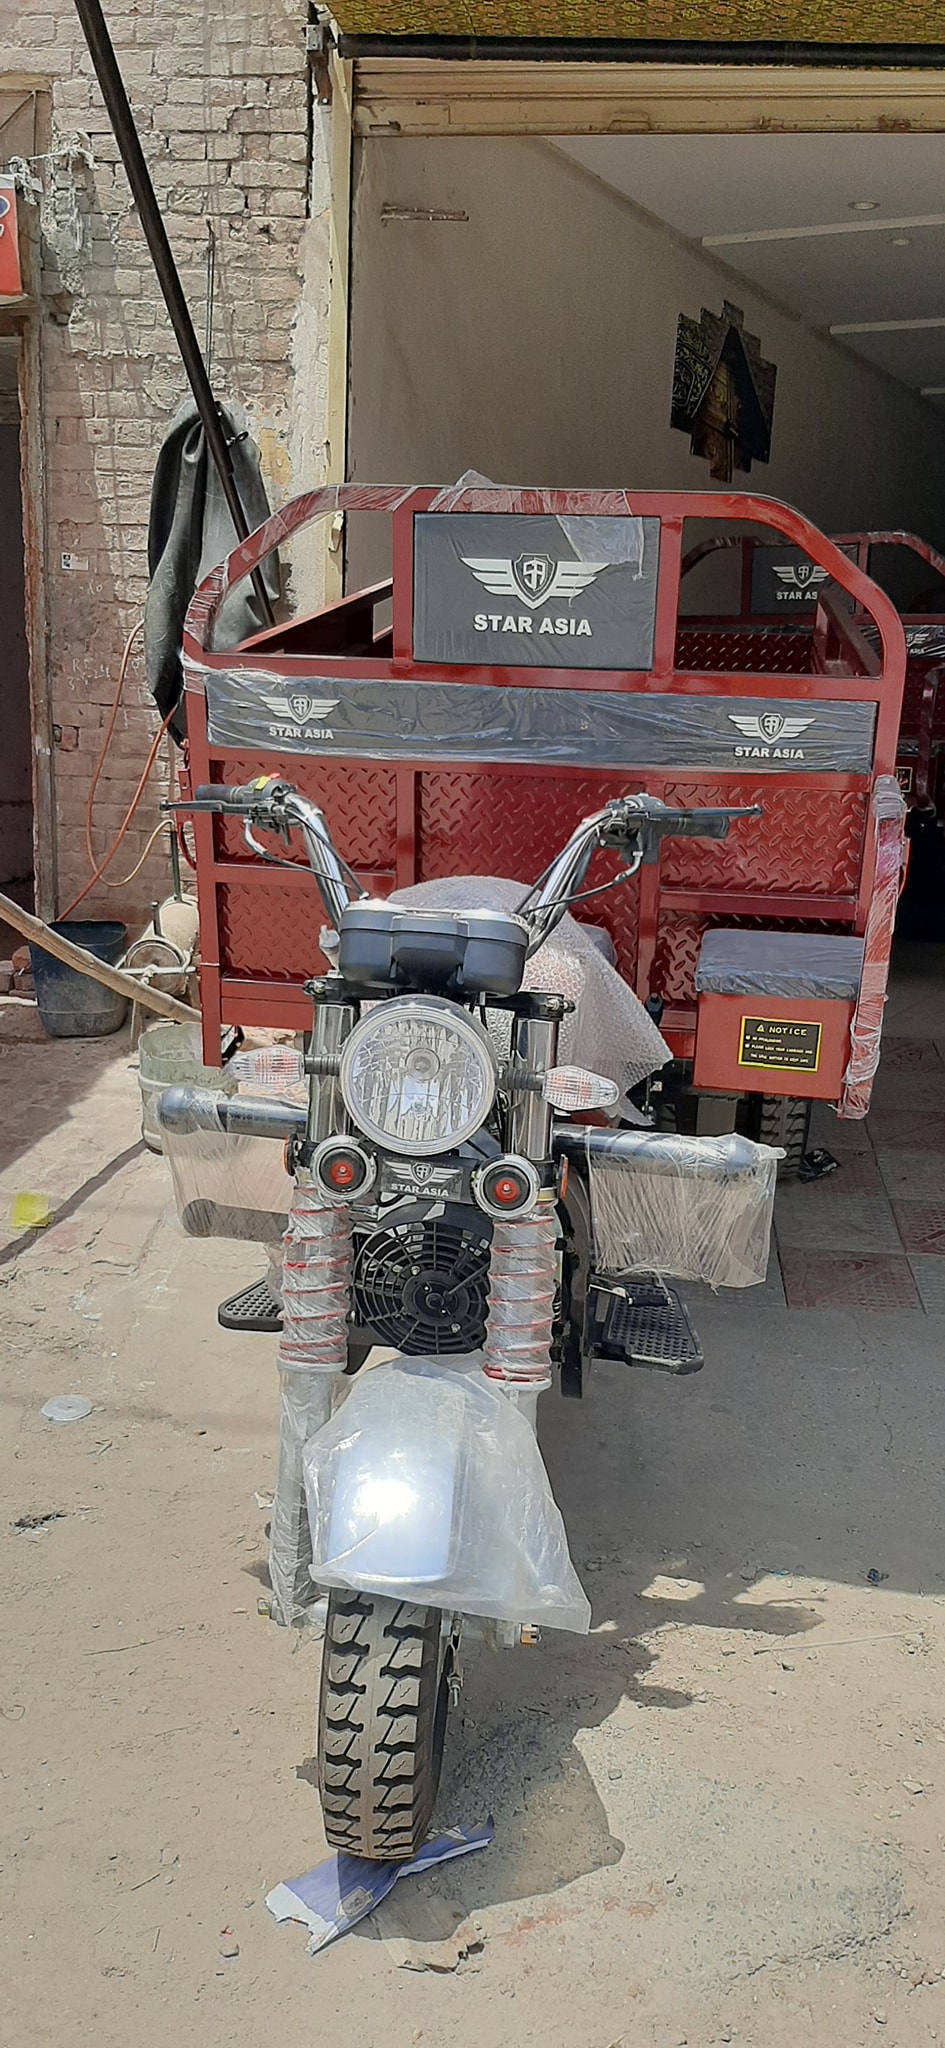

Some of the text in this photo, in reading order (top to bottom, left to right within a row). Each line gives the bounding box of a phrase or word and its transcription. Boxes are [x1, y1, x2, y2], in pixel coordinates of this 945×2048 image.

[776, 591, 818, 600] STAR AS
[474, 614, 593, 636] STAR ASIA
[269, 726, 334, 739] STAR ASIA
[734, 746, 805, 759] STAR ASIA
[768, 1026, 807, 1036] NOTICE
[391, 1183, 449, 1197] STAR ASIA
